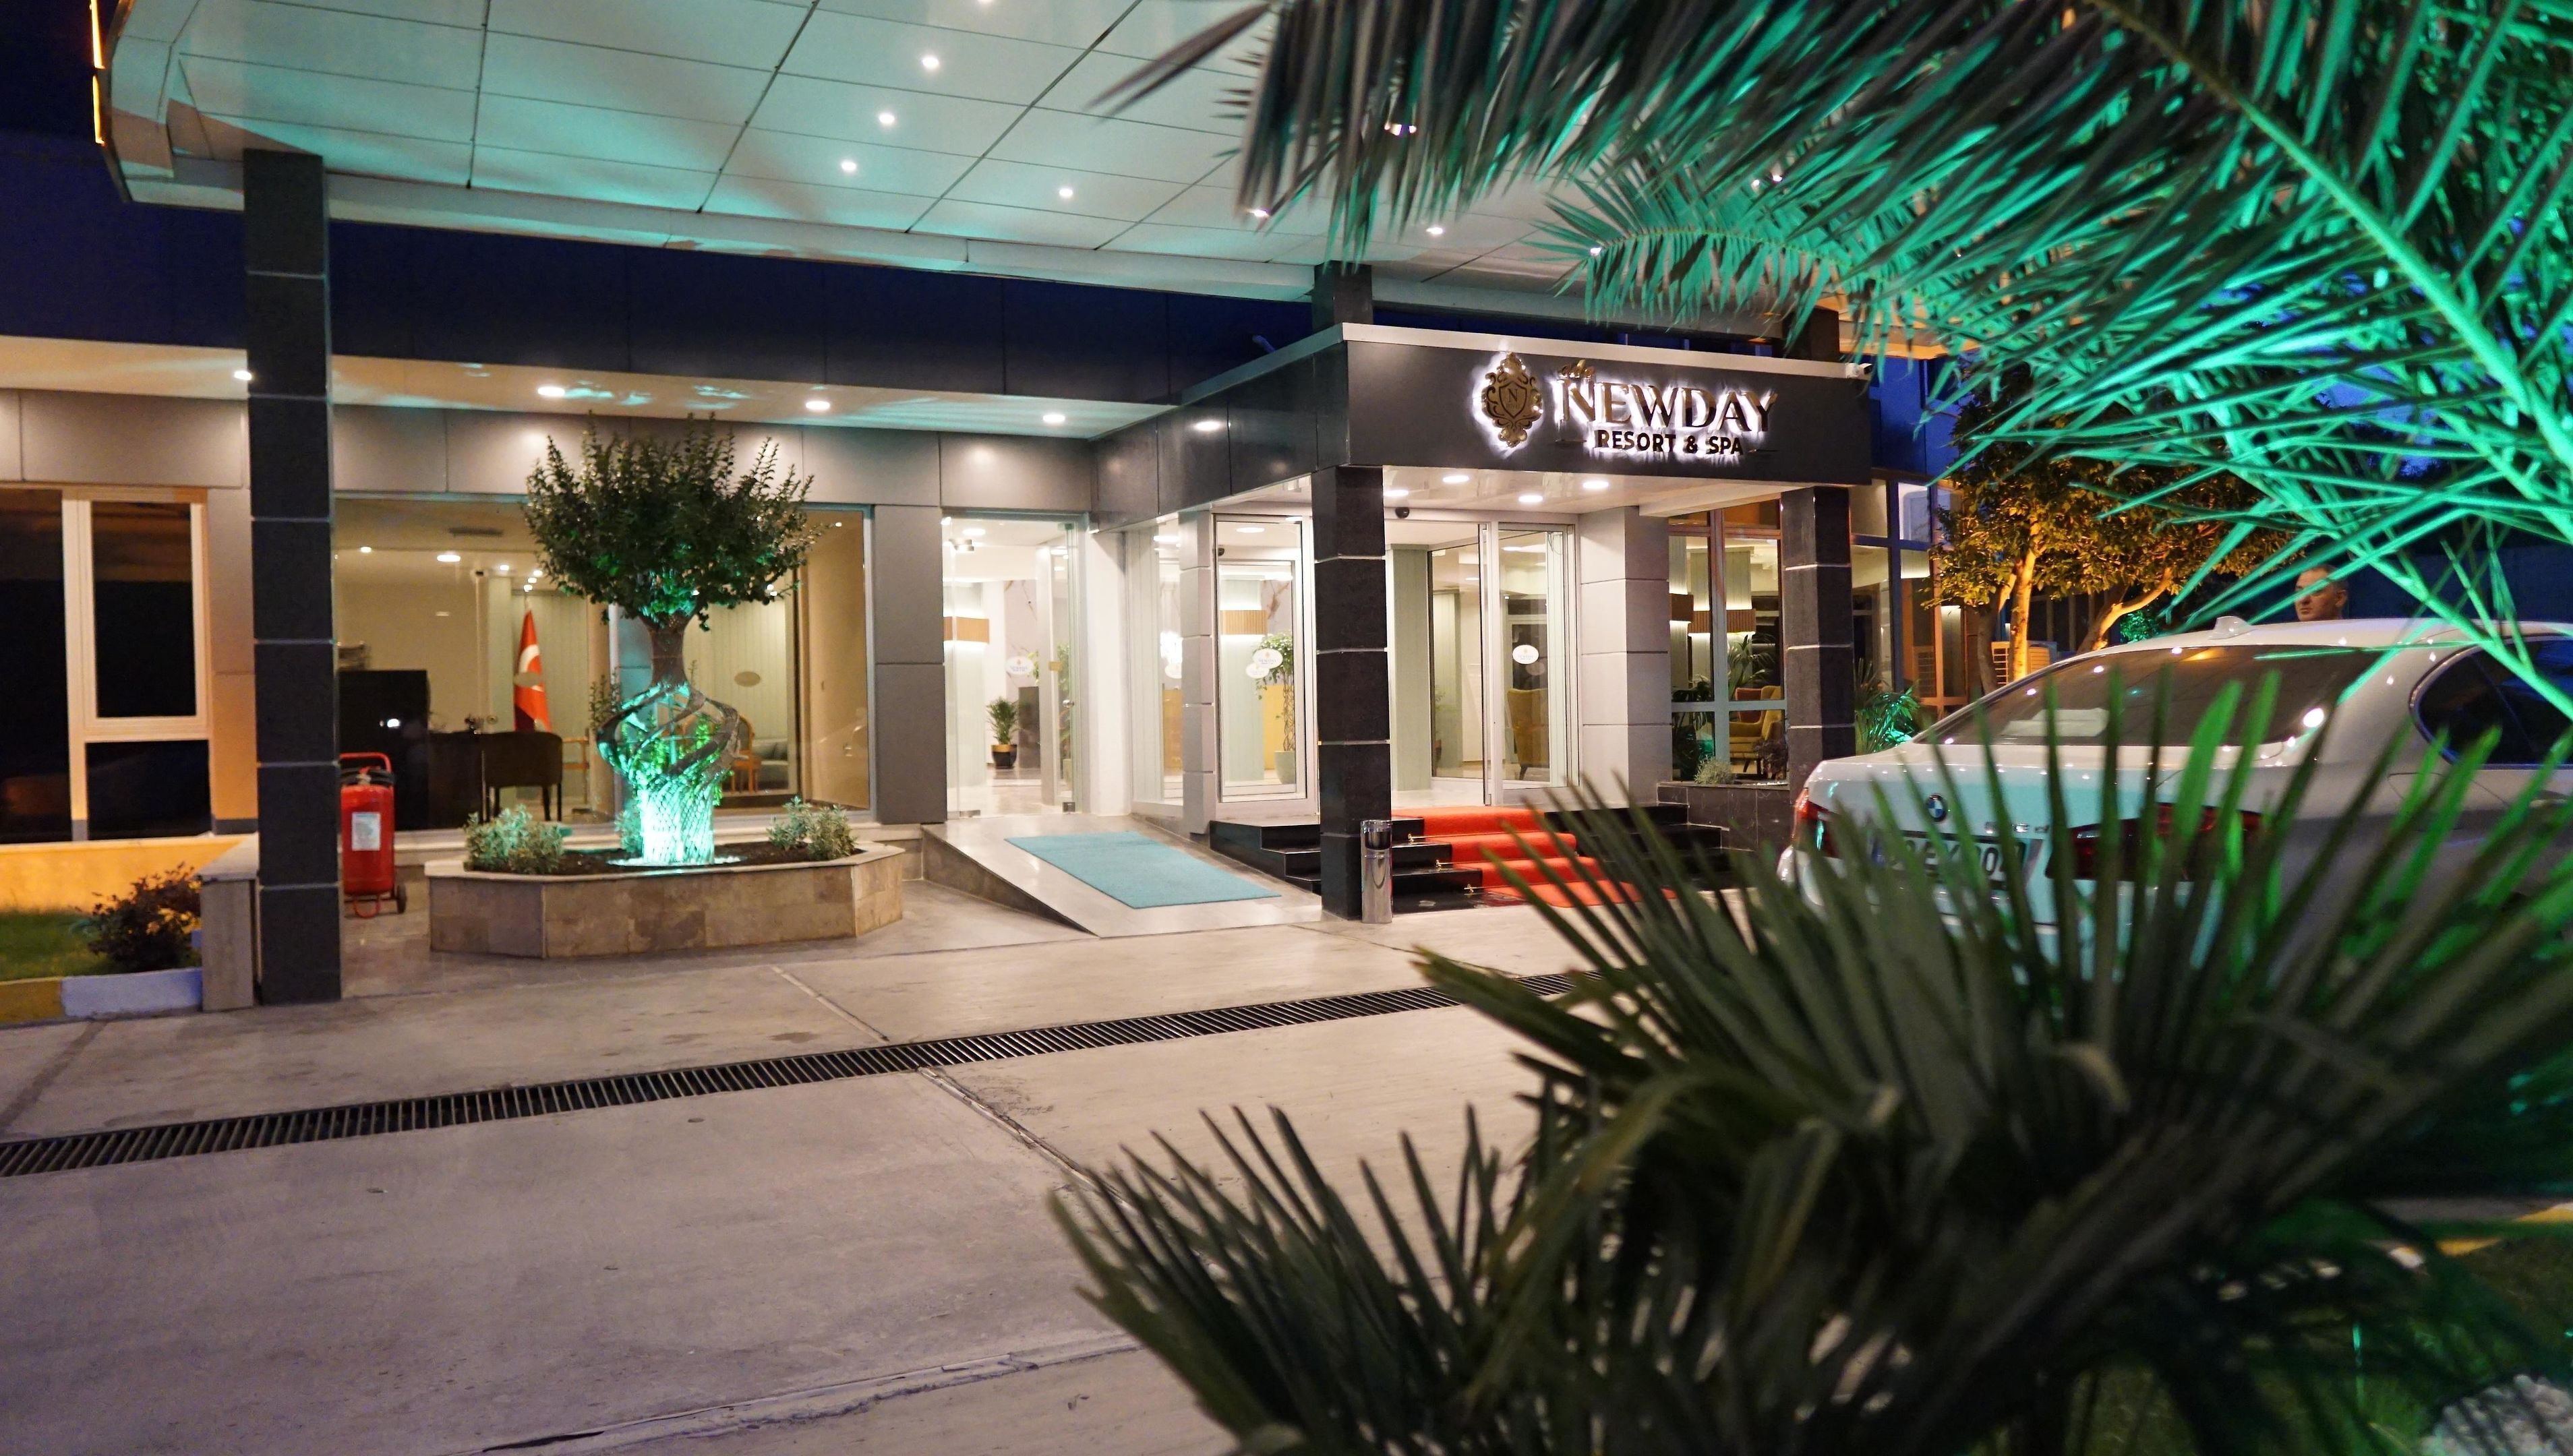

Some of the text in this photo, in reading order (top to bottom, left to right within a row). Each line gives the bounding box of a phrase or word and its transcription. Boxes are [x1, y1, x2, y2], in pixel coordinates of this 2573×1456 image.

[1507, 388, 1518, 403] N
[1559, 378, 1778, 432] NEWDAY
[1594, 429, 1744, 455] RESORT & SPA
